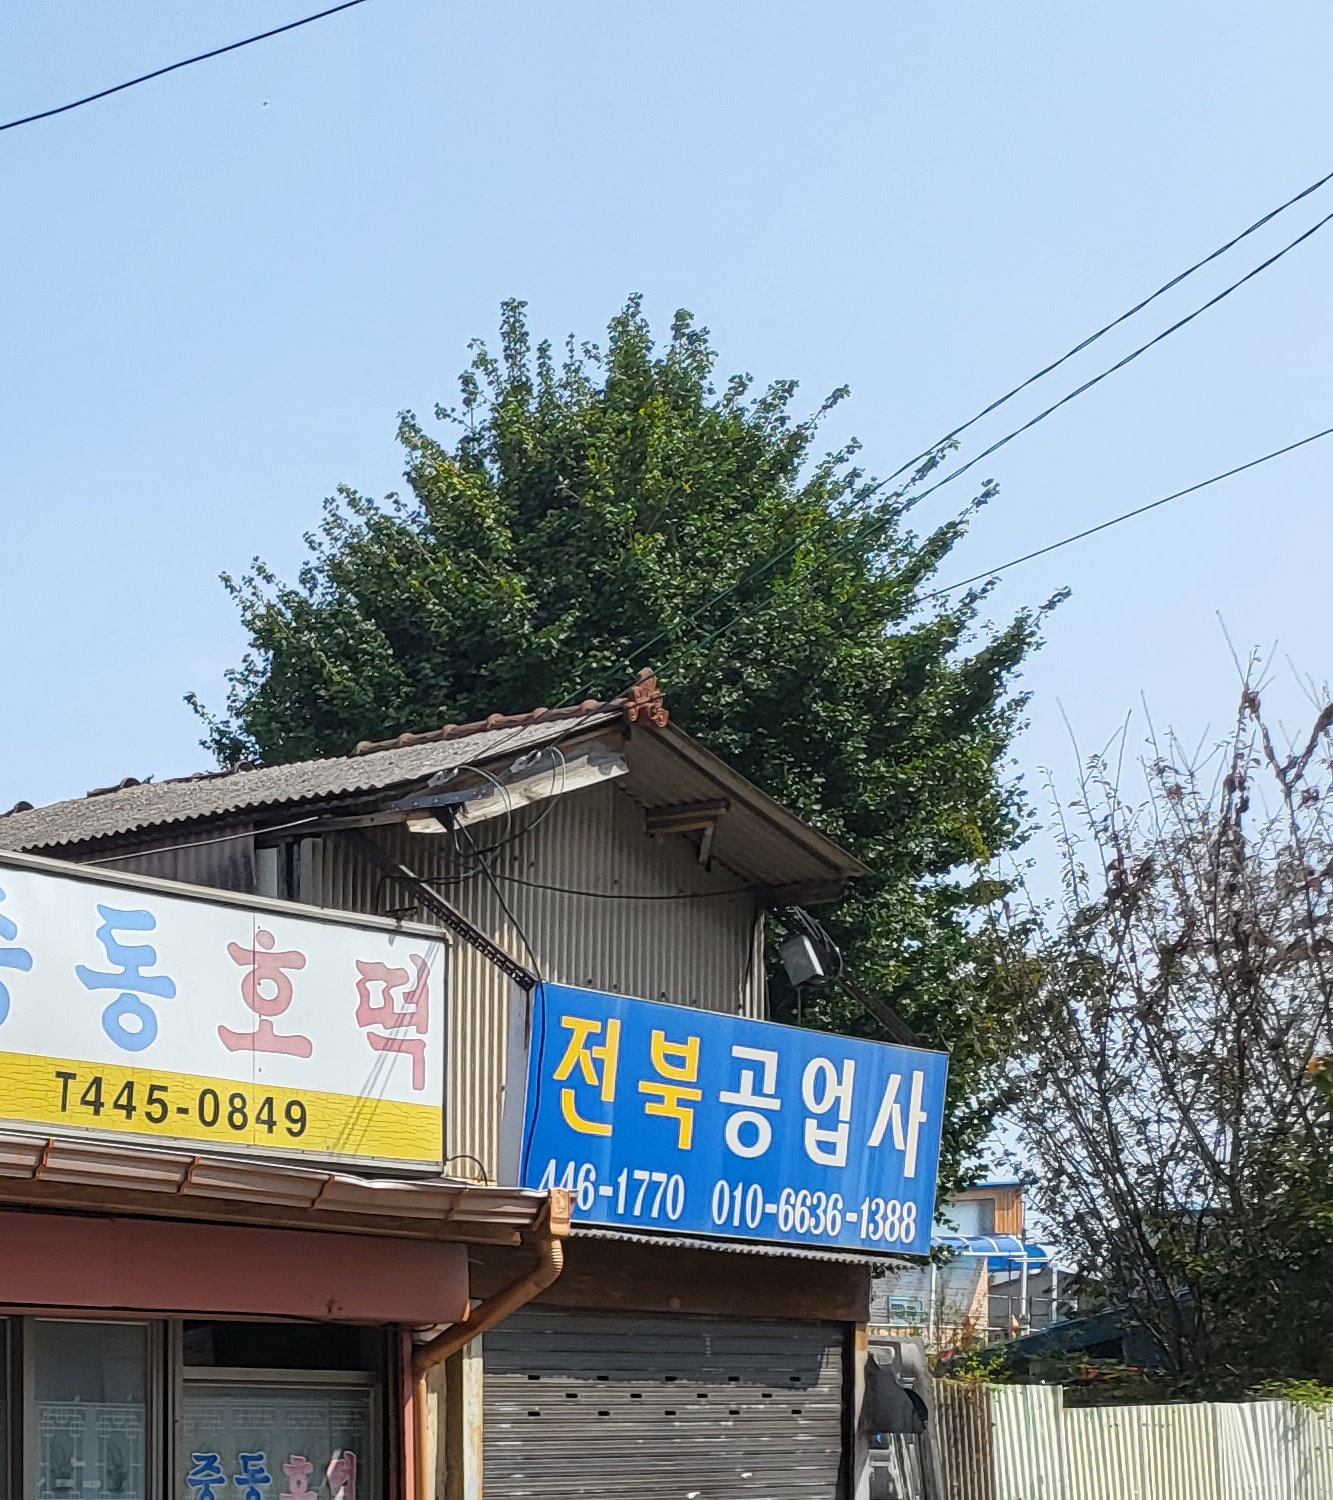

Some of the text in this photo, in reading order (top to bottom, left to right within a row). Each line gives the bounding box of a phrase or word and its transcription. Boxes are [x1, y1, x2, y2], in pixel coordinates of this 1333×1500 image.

[54, 1070, 307, 1138] T445-0849
[552, 1014, 927, 1178] 전북공업사
[537, 1158, 917, 1244] 446-1770 010-6636-1388
